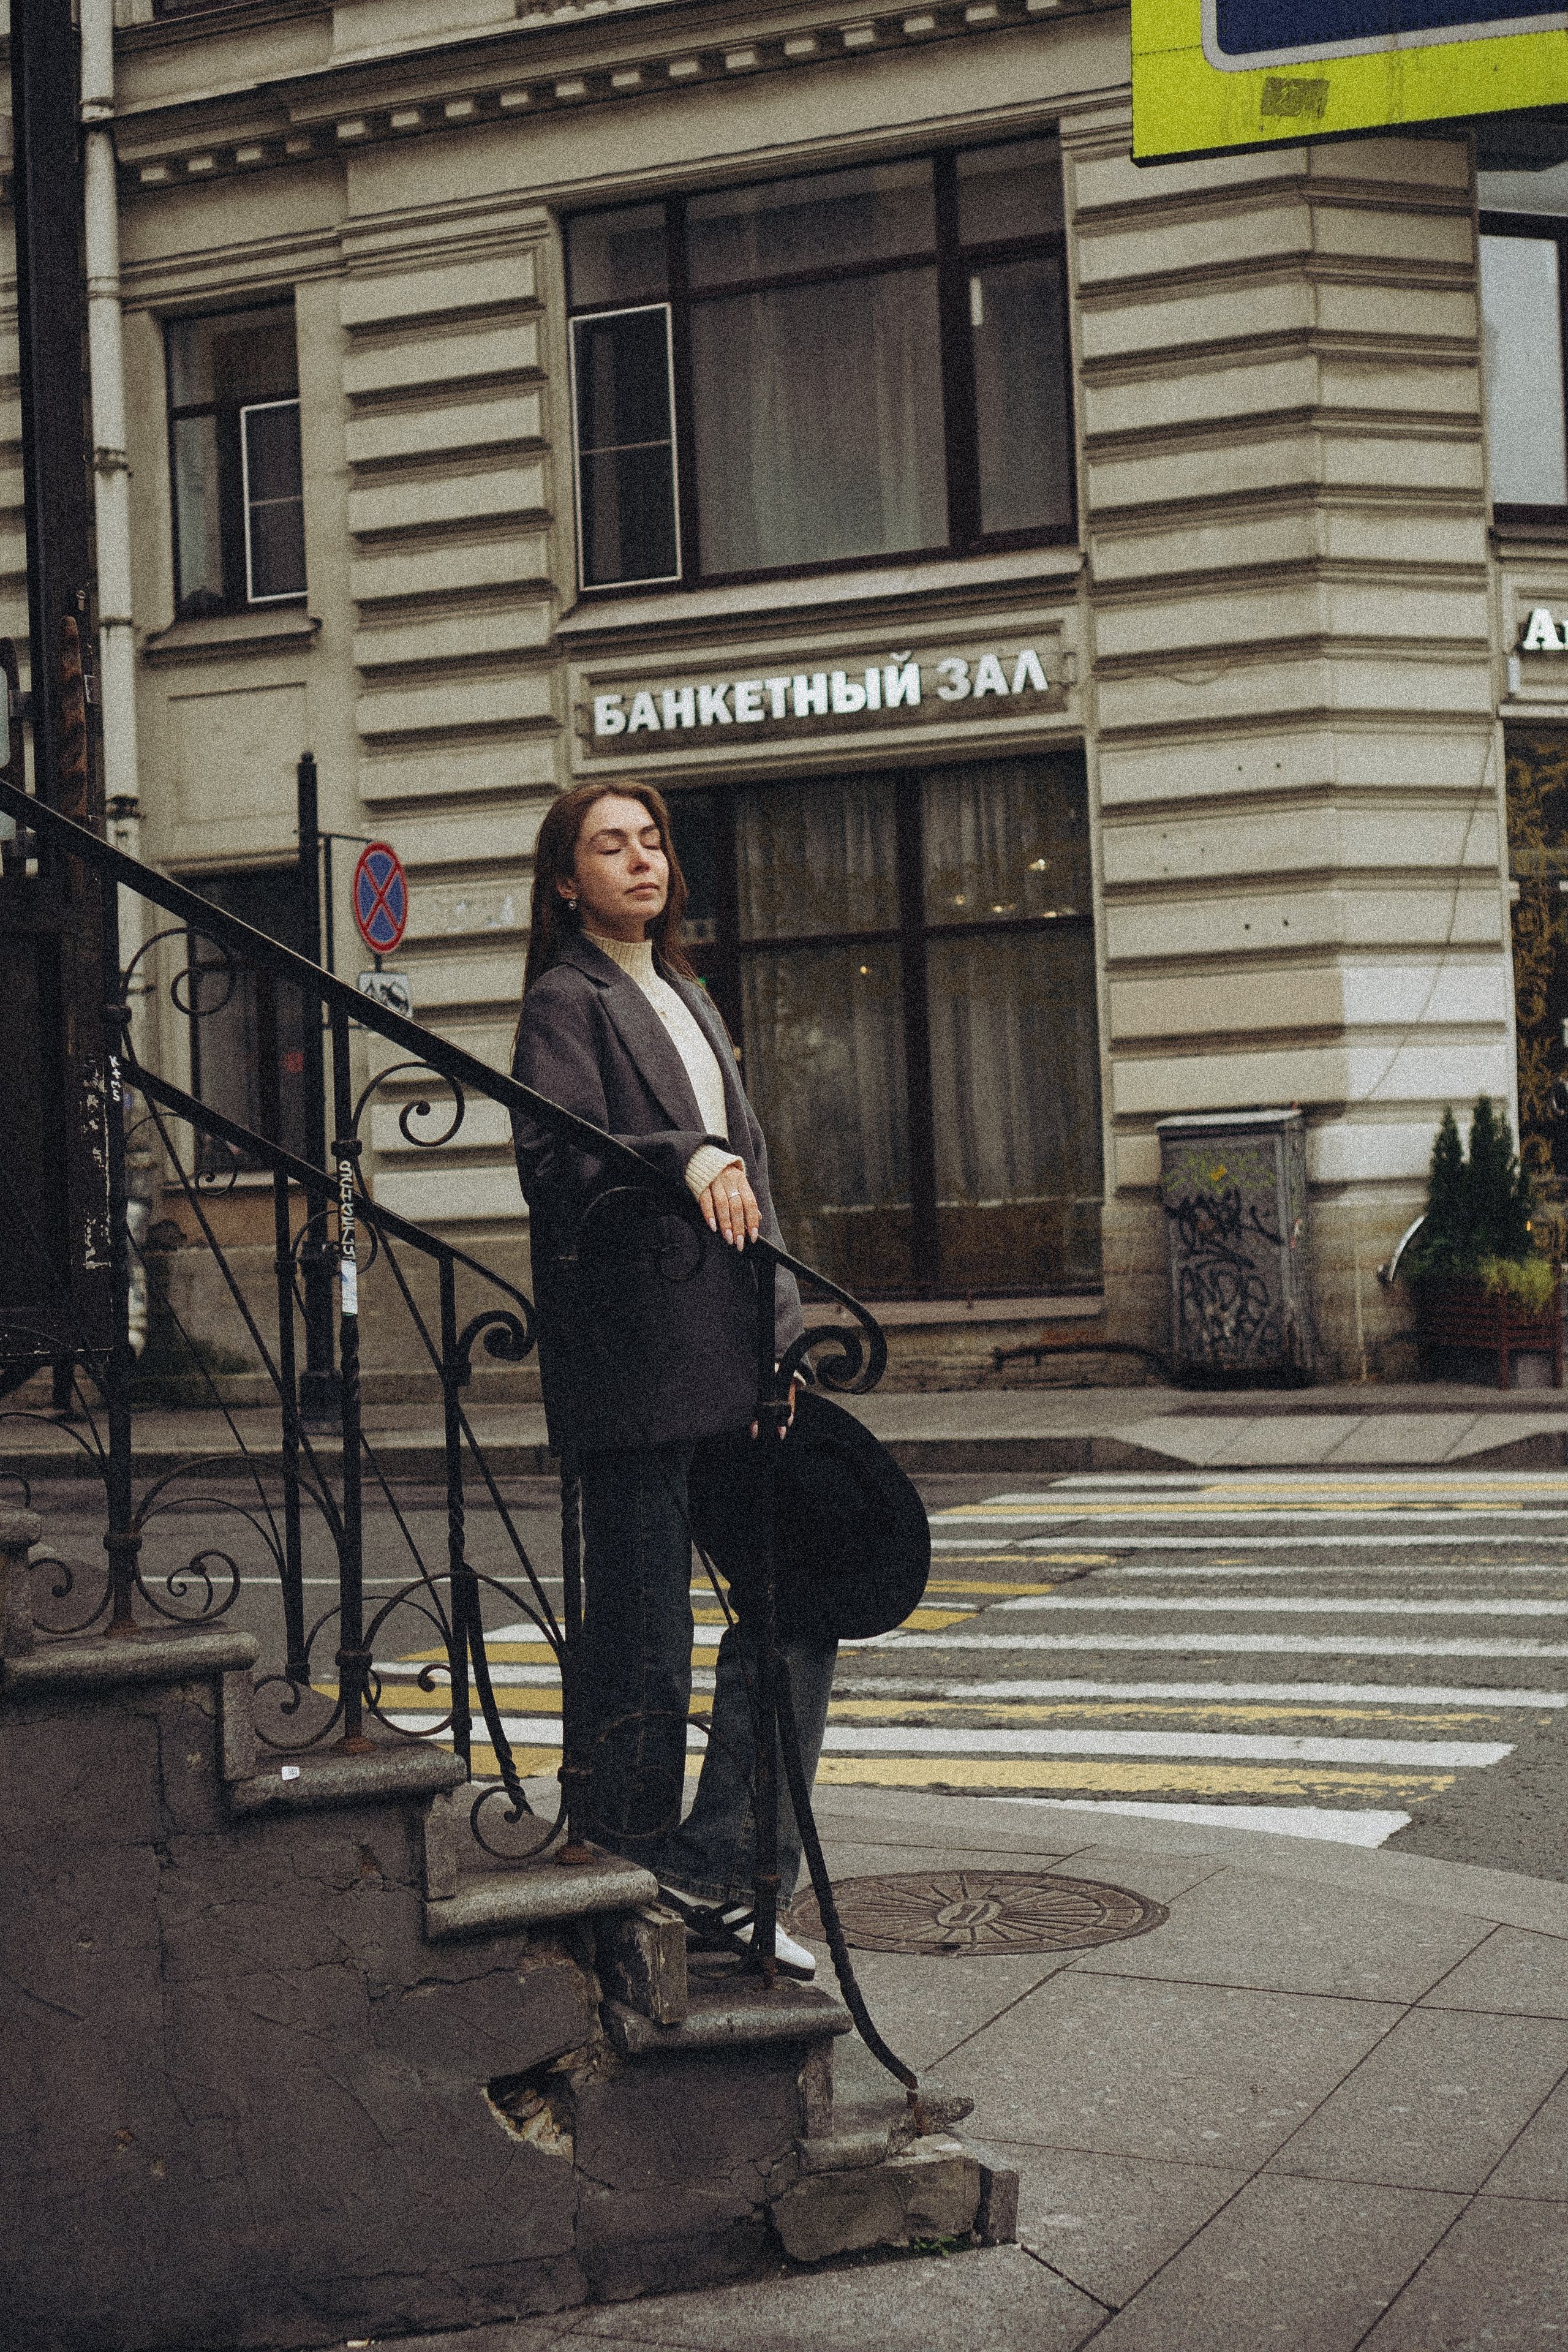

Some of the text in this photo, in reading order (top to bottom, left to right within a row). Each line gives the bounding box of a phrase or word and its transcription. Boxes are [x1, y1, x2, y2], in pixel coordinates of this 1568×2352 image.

[1523, 608, 1568, 650] А
[593, 649, 1049, 735] БАНКЕТНЫЙ ЗАЛ
